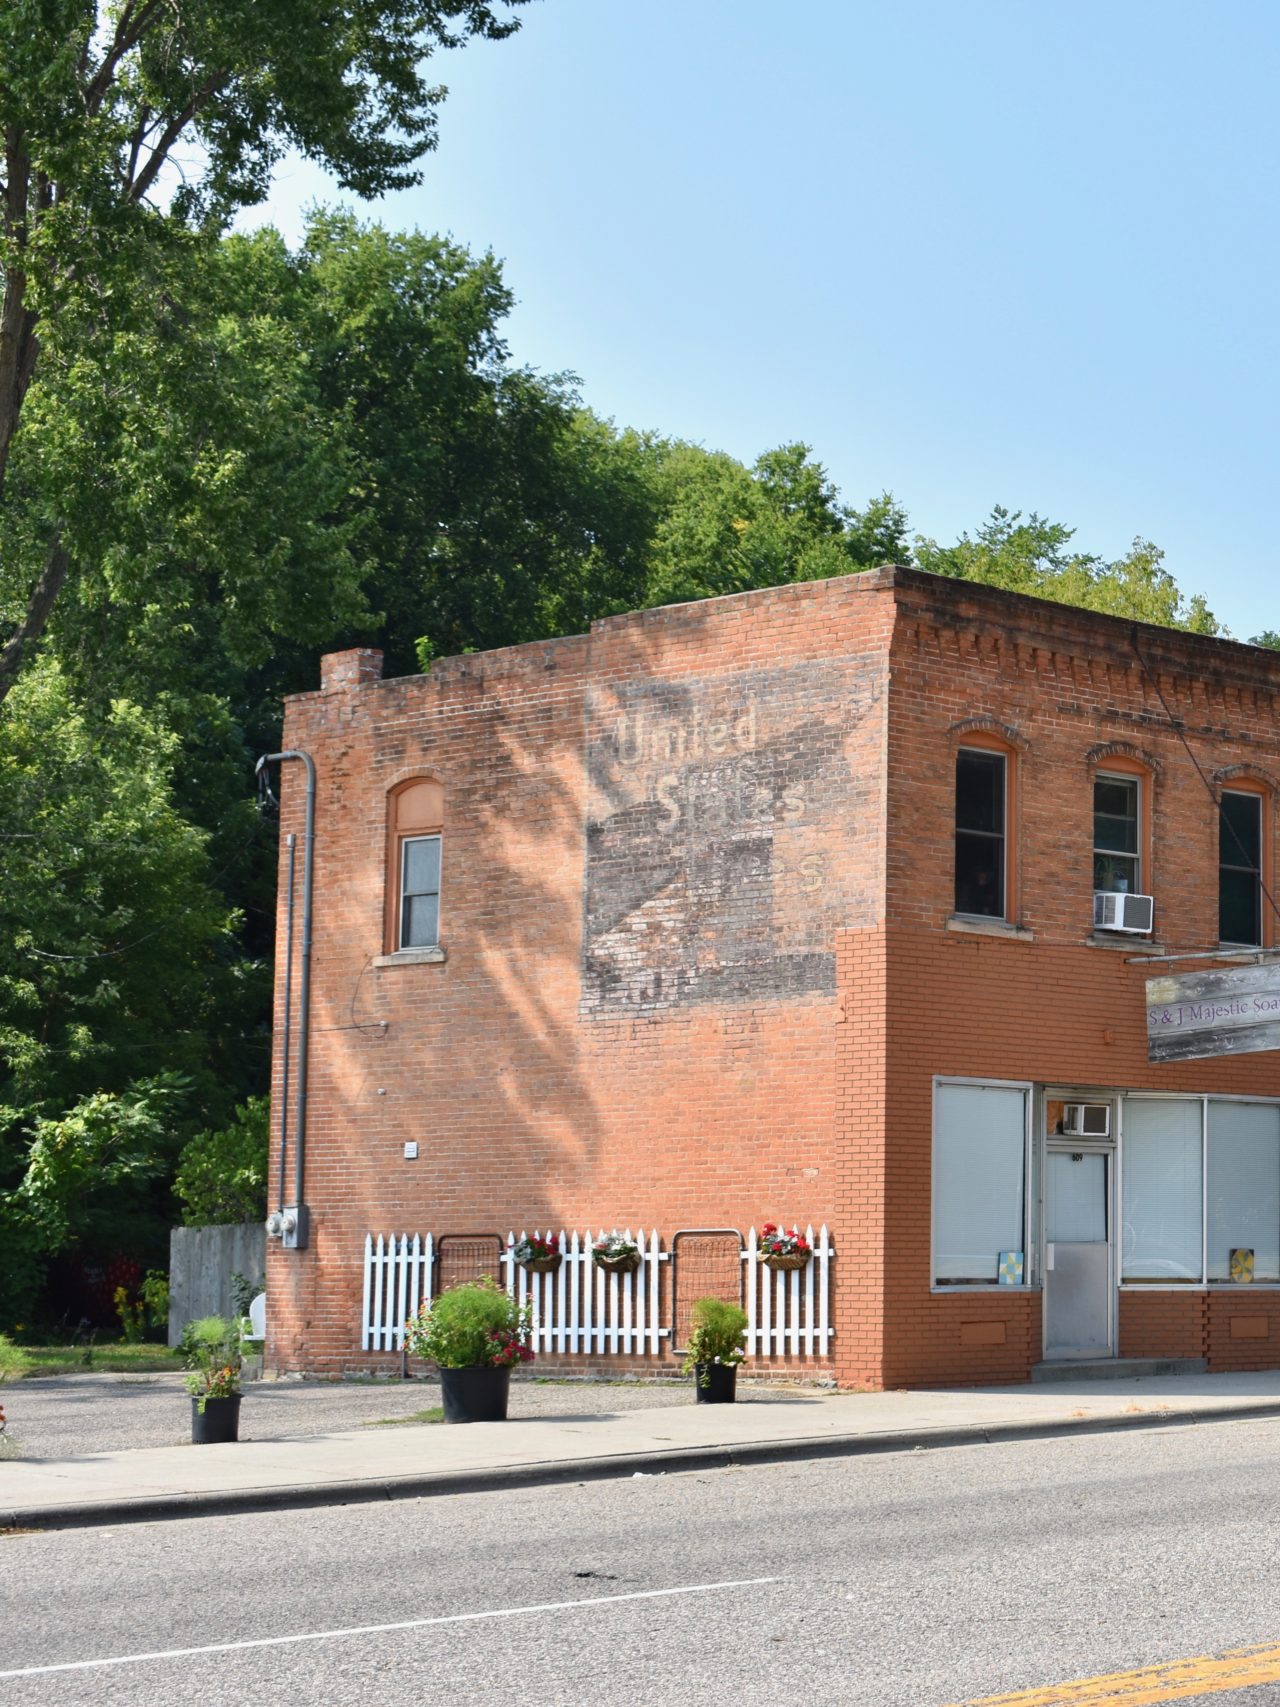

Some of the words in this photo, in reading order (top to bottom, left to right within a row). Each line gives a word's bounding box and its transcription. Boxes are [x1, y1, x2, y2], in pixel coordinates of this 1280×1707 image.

[1149, 1010, 1158, 1026] S
[1161, 1009, 1173, 1025] &
[1177, 1007, 1184, 1026] J
[1189, 1000, 1249, 1023] Majestic
